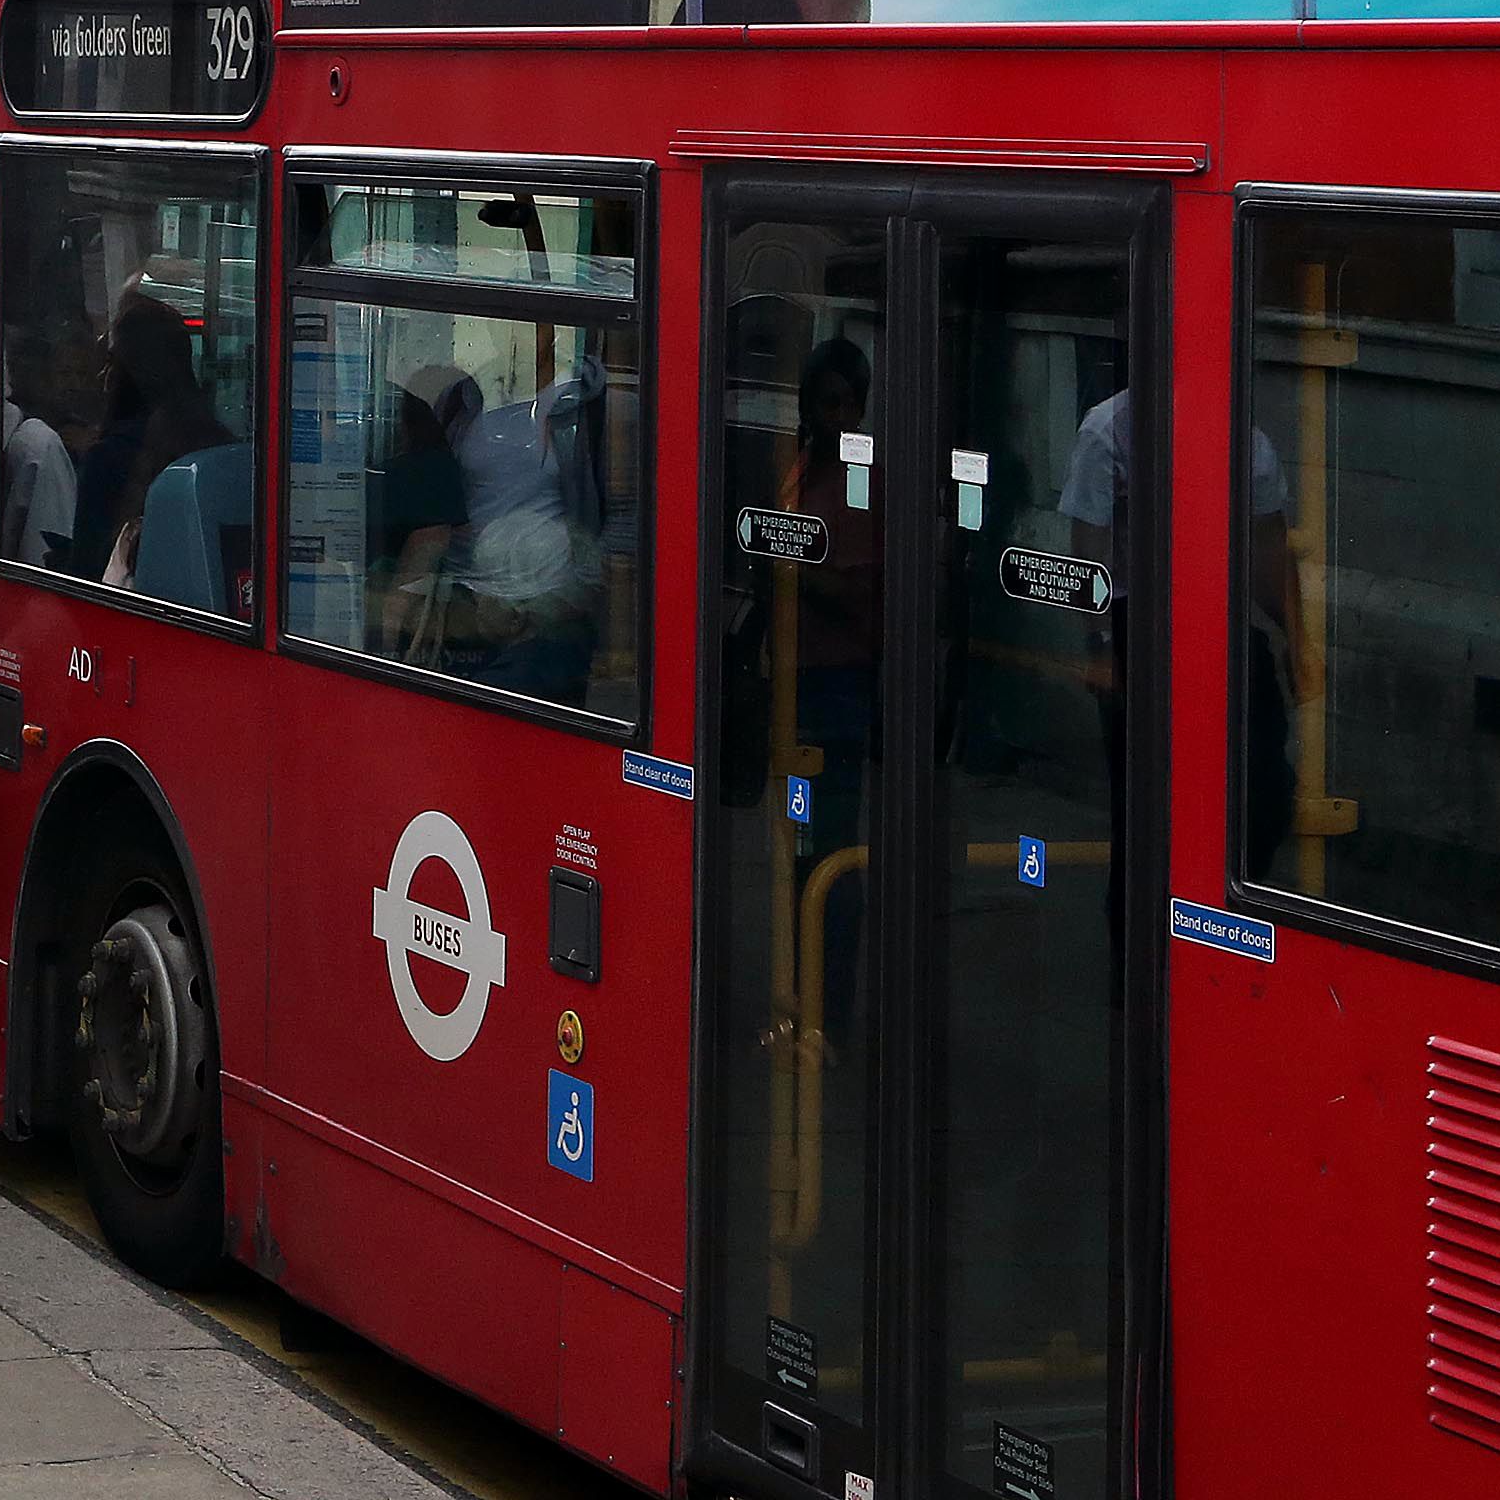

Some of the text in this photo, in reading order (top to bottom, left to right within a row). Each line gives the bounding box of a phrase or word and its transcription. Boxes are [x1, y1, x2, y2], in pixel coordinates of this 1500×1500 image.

[52, 6, 254, 80] via Golders Green 329
[753, 514, 820, 534] IN EMERGENCY ONLY
[761, 528, 812, 545] PULL OUTWARD
[770, 542, 804, 557] AND SLIDE
[1010, 553, 1091, 579] IN EMERGENCY ONLY
[1018, 568, 1081, 591] PULL OUTWARD
[1029, 584, 1071, 603] AND SLIDE
[69, 646, 92, 682] AD
[624, 759, 692, 790] Stand clear of doors
[562, 824, 591, 841] OPEN FLAP
[555, 834, 598, 856] FOR EMERGENCY
[556, 848, 598, 870] DOOR CONTROL
[414, 914, 461, 957] BUSES
[1174, 910, 1271, 950] Stand clear of doors
